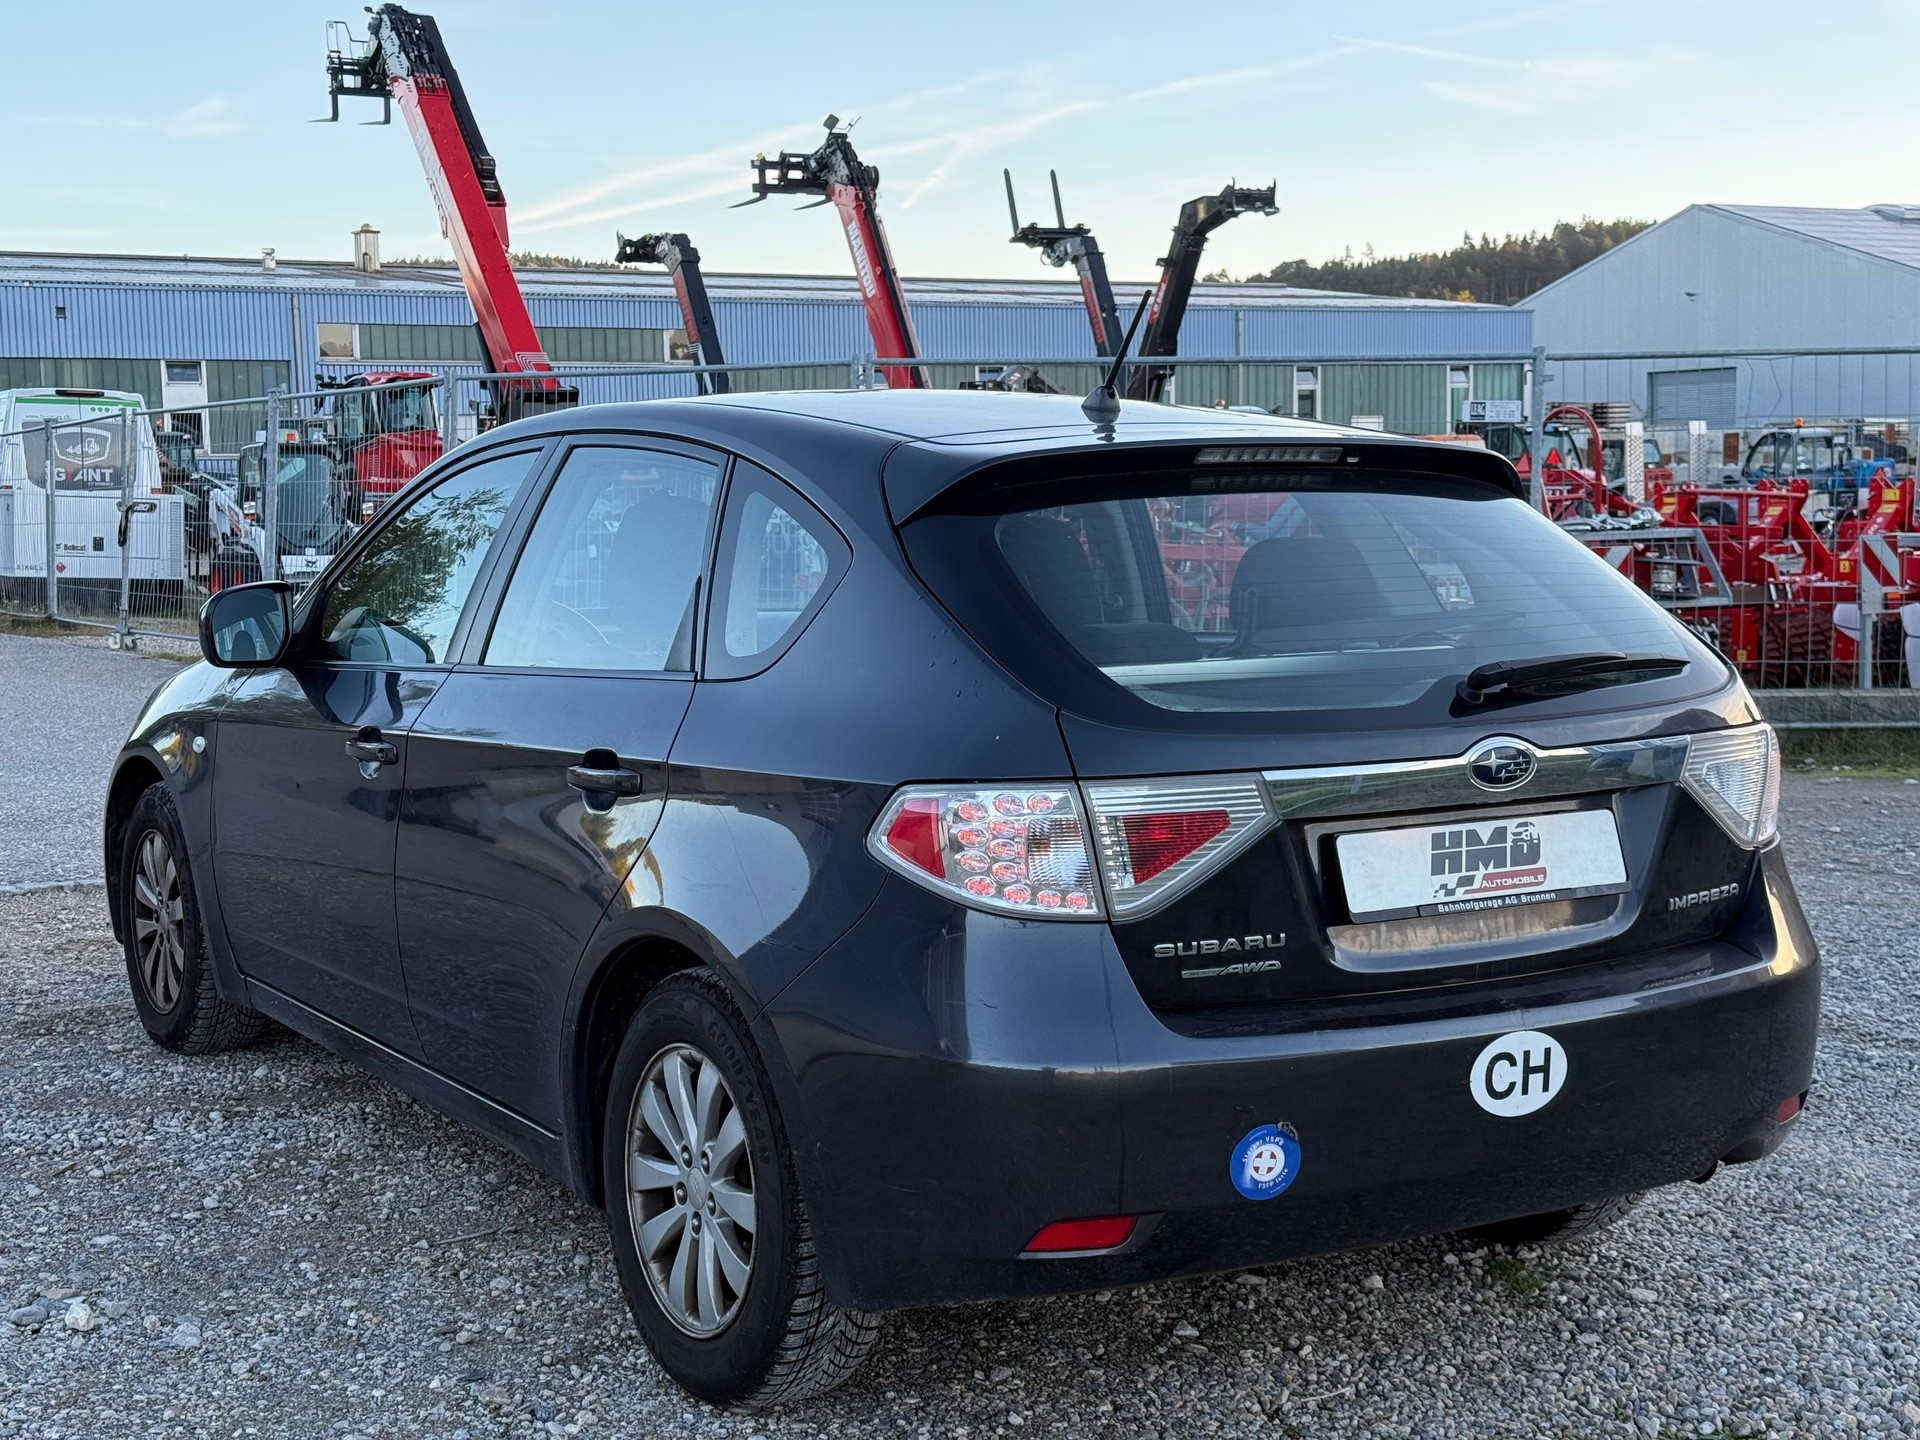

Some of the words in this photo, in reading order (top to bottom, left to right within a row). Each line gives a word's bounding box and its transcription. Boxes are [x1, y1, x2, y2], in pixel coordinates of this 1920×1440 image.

[847, 220, 876, 298] MANITOU
[54, 465, 114, 482] GIANT
[63, 543, 86, 552] Bobcat
[1481, 874, 1545, 889] AUTOMOBILE
[1438, 899, 1503, 913] Bahnhofgarage
[1505, 895, 1518, 905] AG
[1520, 892, 1557, 903] Brunnen
[1667, 883, 1740, 911] IMPREZA
[1154, 933, 1286, 958] SUBARU
[1220, 960, 1282, 976] AWD
[1485, 1047, 1551, 1100] CH
